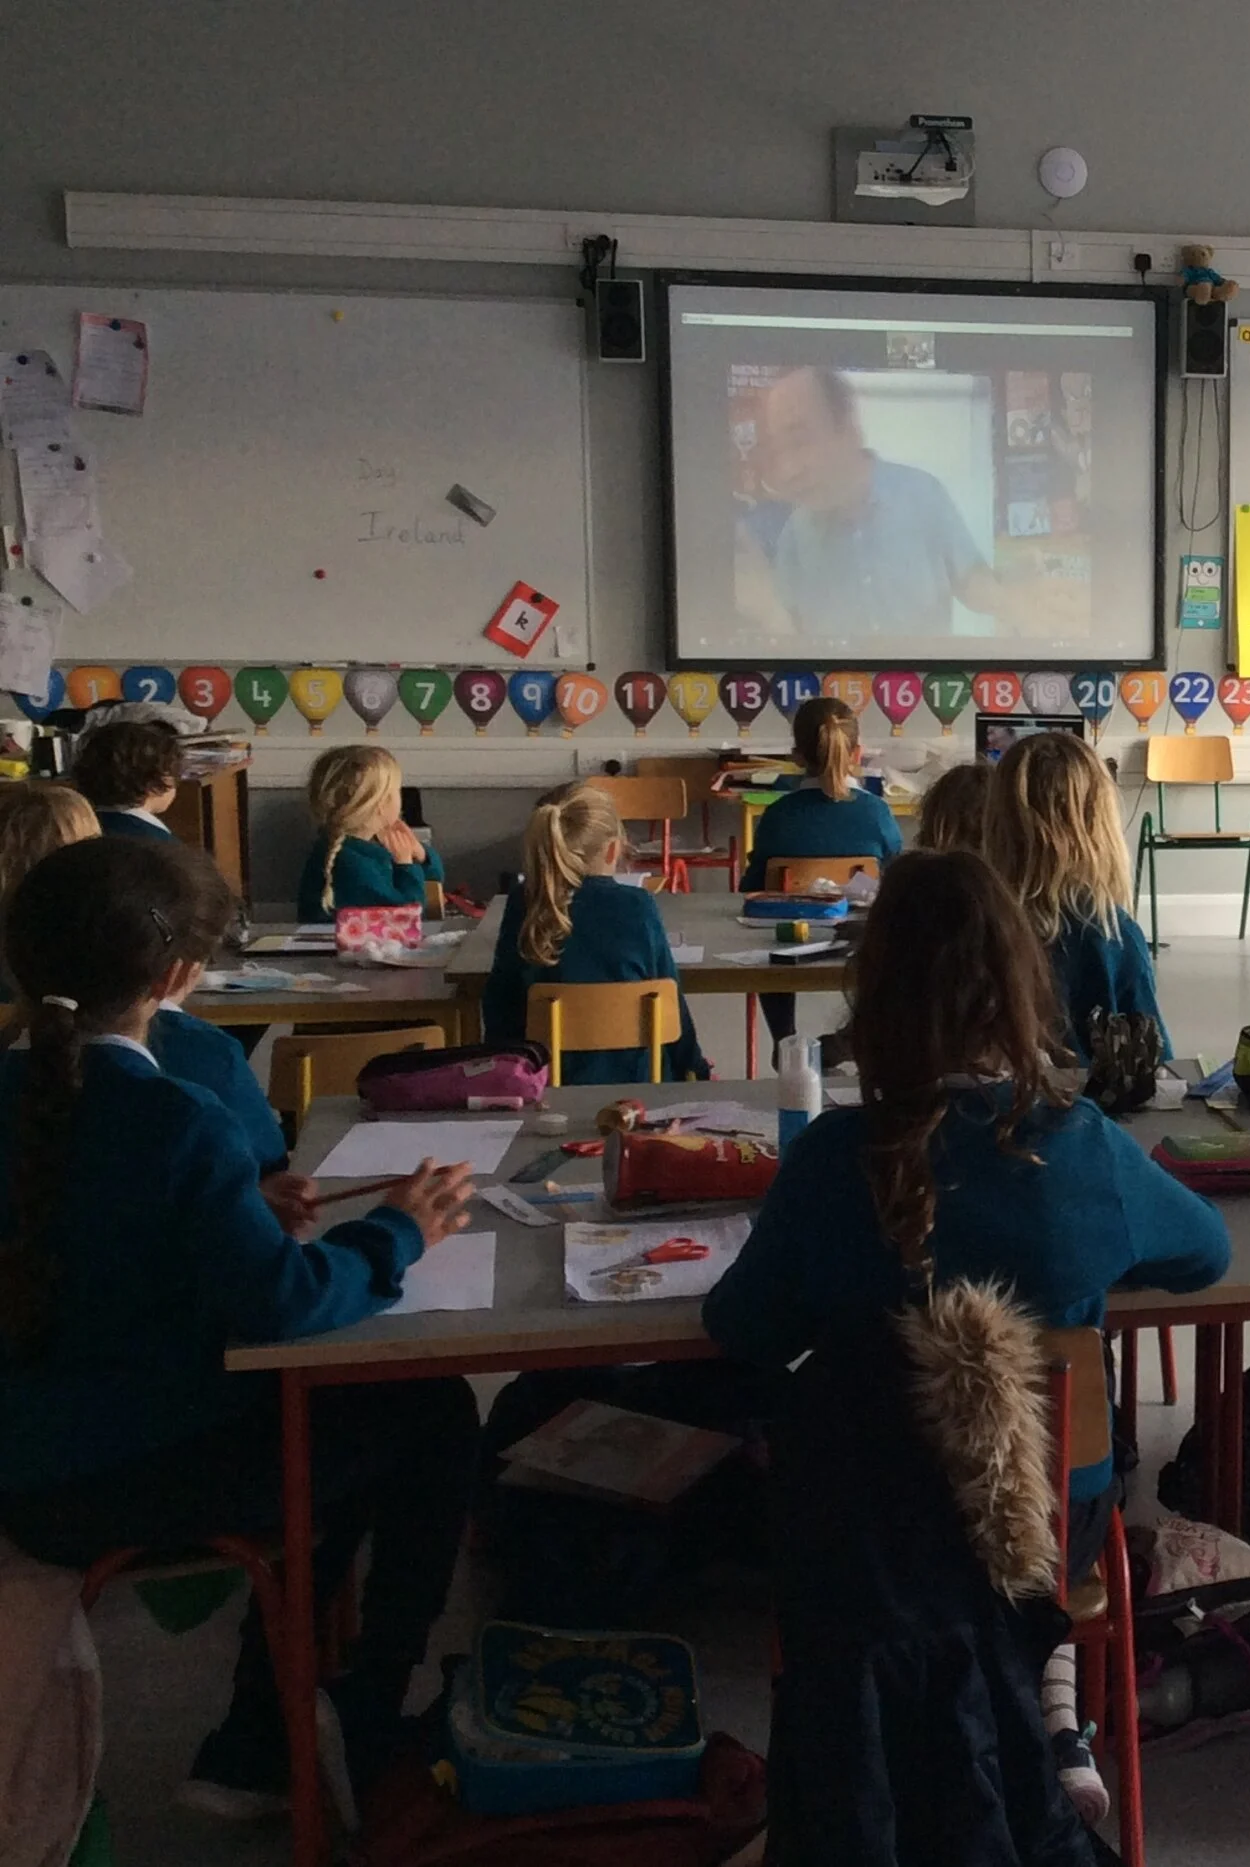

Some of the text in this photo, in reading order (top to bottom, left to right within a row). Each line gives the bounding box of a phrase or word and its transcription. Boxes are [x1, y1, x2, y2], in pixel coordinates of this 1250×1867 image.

[357, 511, 465, 544] Ireland
[514, 611, 529, 630] k
[87, 680, 98, 703] 1
[139, 679, 158, 703] 2
[194, 680, 213, 707] 3
[252, 680, 272, 707] 4
[307, 680, 325, 707] 5
[362, 683, 381, 709] 6
[415, 683, 436, 709] 7
[470, 683, 491, 711] 8
[522, 683, 541, 710] 9
[561, 682, 598, 714] 10
[622, 682, 655, 709] 11
[674, 682, 709, 709] 12
[726, 681, 762, 708] 13
[777, 681, 810, 705] 14
[829, 681, 864, 706] 15
[880, 681, 914, 707] 16
[930, 681, 963, 707] 17
[979, 681, 1013, 707] 18
[1029, 682, 1061, 707] 19
[1078, 680, 1114, 707] 20
[1128, 679, 1159, 704] 21
[1174, 678, 1210, 703] 22
